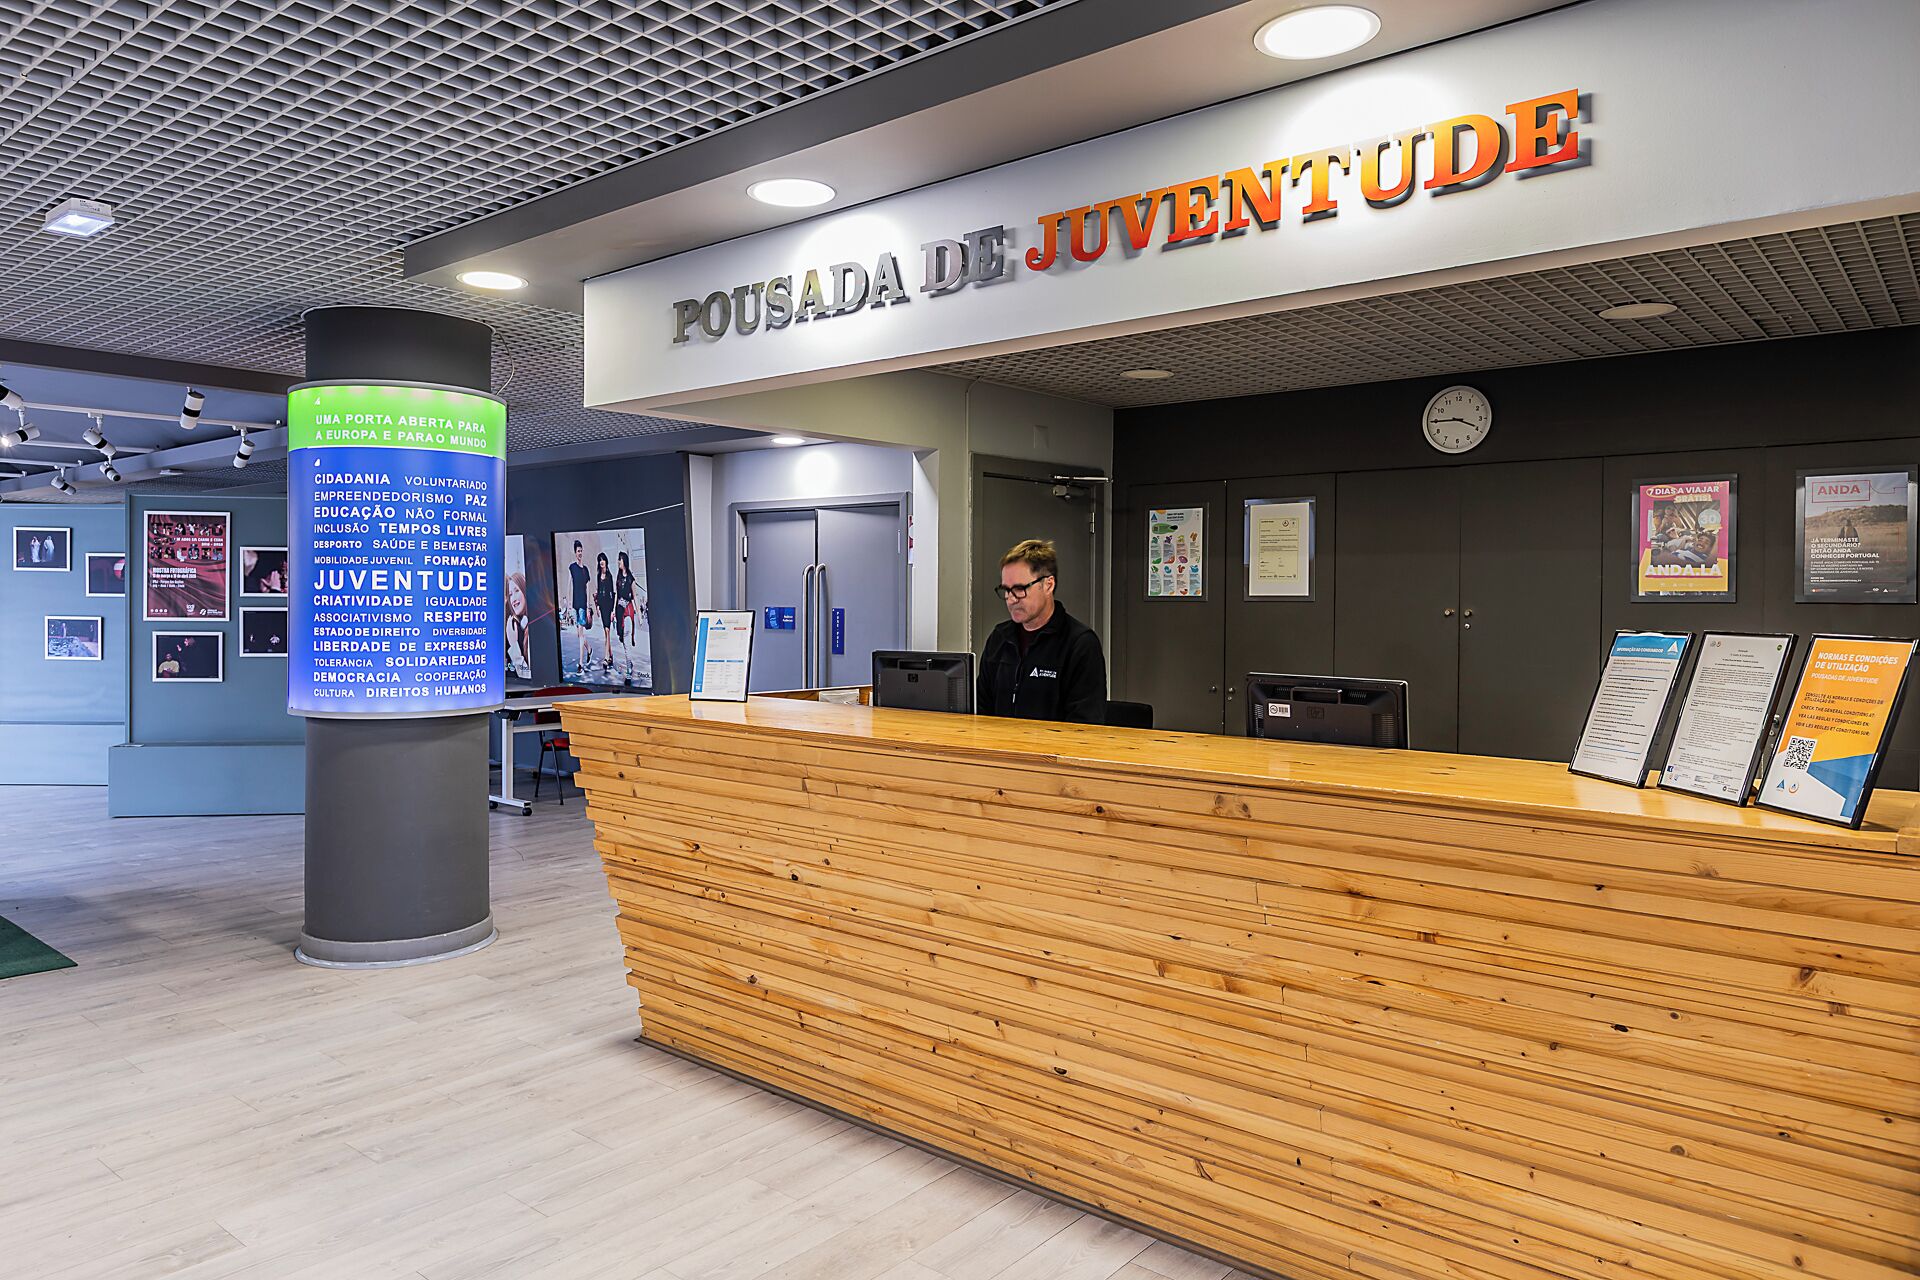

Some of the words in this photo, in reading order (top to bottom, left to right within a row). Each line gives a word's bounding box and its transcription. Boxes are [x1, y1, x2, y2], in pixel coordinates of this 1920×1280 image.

[672, 251, 909, 344] POUSADA
[920, 225, 1008, 293] DE
[1025, 88, 1583, 271] JUVENTUDE
[316, 415, 340, 425] UMA
[346, 414, 392, 425] PORTA
[398, 416, 453, 430] ABERTA
[458, 421, 486, 434] PARA
[316, 432, 322, 440] A
[326, 430, 377, 440] EUROPA
[384, 431, 391, 440] E
[450, 436, 486, 448] MUNDO
[314, 474, 390, 485] CIDADANIA
[405, 476, 487, 490] VOLUNTARIADO
[1817, 485, 1860, 495] ANDA
[314, 492, 453, 504] EMPREENDEDORISMO
[465, 494, 487, 507] PAZ
[314, 505, 395, 520] EDUCAÇÃO
[406, 508, 434, 519] NÃO
[444, 511, 487, 523] FORMAL
[314, 522, 369, 533] INCLUSÃO
[379, 523, 440, 535] TEMPOS
[447, 526, 487, 538] LIVRES
[373, 538, 415, 550] SAÚDE
[421, 541, 428, 549] E
[434, 542, 457, 550] BEM
[459, 542, 487, 552] ESTAR
[370, 557, 413, 565] JUVENIL
[424, 556, 487, 568] FORMAÇÃO
[314, 570, 487, 591] JUVENTUDE
[314, 595, 413, 607] CRIATIVIDADE
[426, 597, 487, 607] IGUALDADE
[314, 613, 411, 623] ASSOCIATIVISMO
[424, 611, 487, 622] RESPEITO
[314, 628, 353, 636] ESTADO
[355, 628, 370, 636] DE
[372, 628, 420, 636] DIREITO
[433, 627, 486, 636] DIVERSIDADE
[314, 641, 390, 652] LIBERDADE
[400, 642, 416, 652] DE
[425, 640, 486, 652] EXPRESSÃO
[314, 658, 373, 667] TOLERÂNCIA
[386, 655, 486, 667] SOLIDARIEDADE
[1818, 652, 1848, 660] NORMAS
[1855, 654, 1898, 665] CONDIÇÕES
[1827, 662, 1869, 673] UTILIZAÇÃO
[314, 672, 401, 682] DEMOCRACIA
[415, 670, 486, 682] COOPERAÇÃO
[1846, 676, 1879, 684] JUVENTUDE
[314, 688, 355, 697] CULTURA
[366, 687, 429, 697] DIREITOS
[435, 684, 486, 696] HUMANOS
